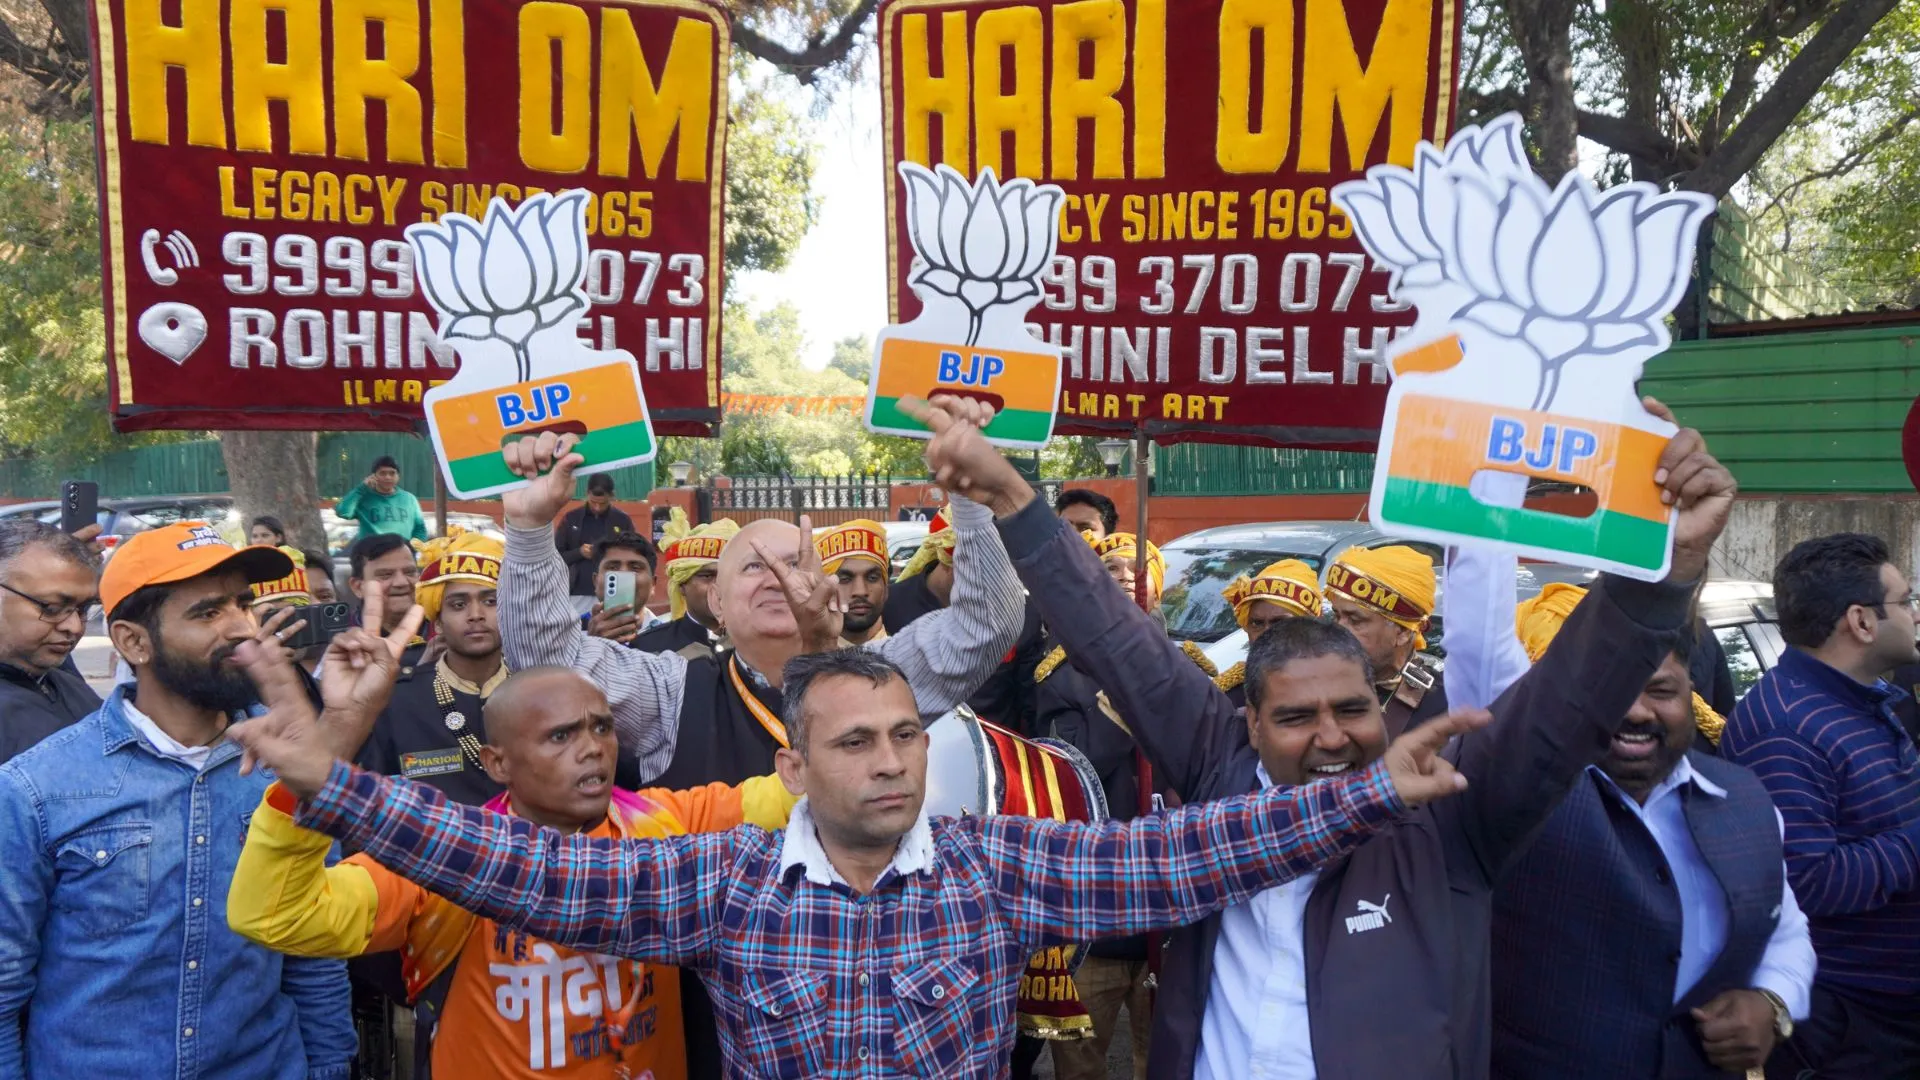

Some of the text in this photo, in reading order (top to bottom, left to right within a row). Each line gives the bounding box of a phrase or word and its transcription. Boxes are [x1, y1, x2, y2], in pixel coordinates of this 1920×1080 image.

[123, 0, 713, 182] HARI OM
[902, 0, 1434, 180] HARI OM
[218, 166, 407, 226] LEGACY
[1122, 190, 1239, 242] SINCE
[222, 232, 704, 308] 9999 073
[1044, 255, 1117, 312] 99
[1138, 254, 1258, 314] 370
[230, 306, 455, 369] ROHIN
[1025, 323, 1412, 385] HINI DELH
[938, 352, 1004, 387] BJP
[495, 383, 571, 428] BJP
[1061, 391, 1230, 420] LMAT ART
[1487, 416, 1598, 473] BJP
[369, 506, 408, 522] GAP
[440, 555, 499, 578] HAR
[1328, 565, 1398, 610] RI OM
[1345, 912, 1384, 934] PUMA
